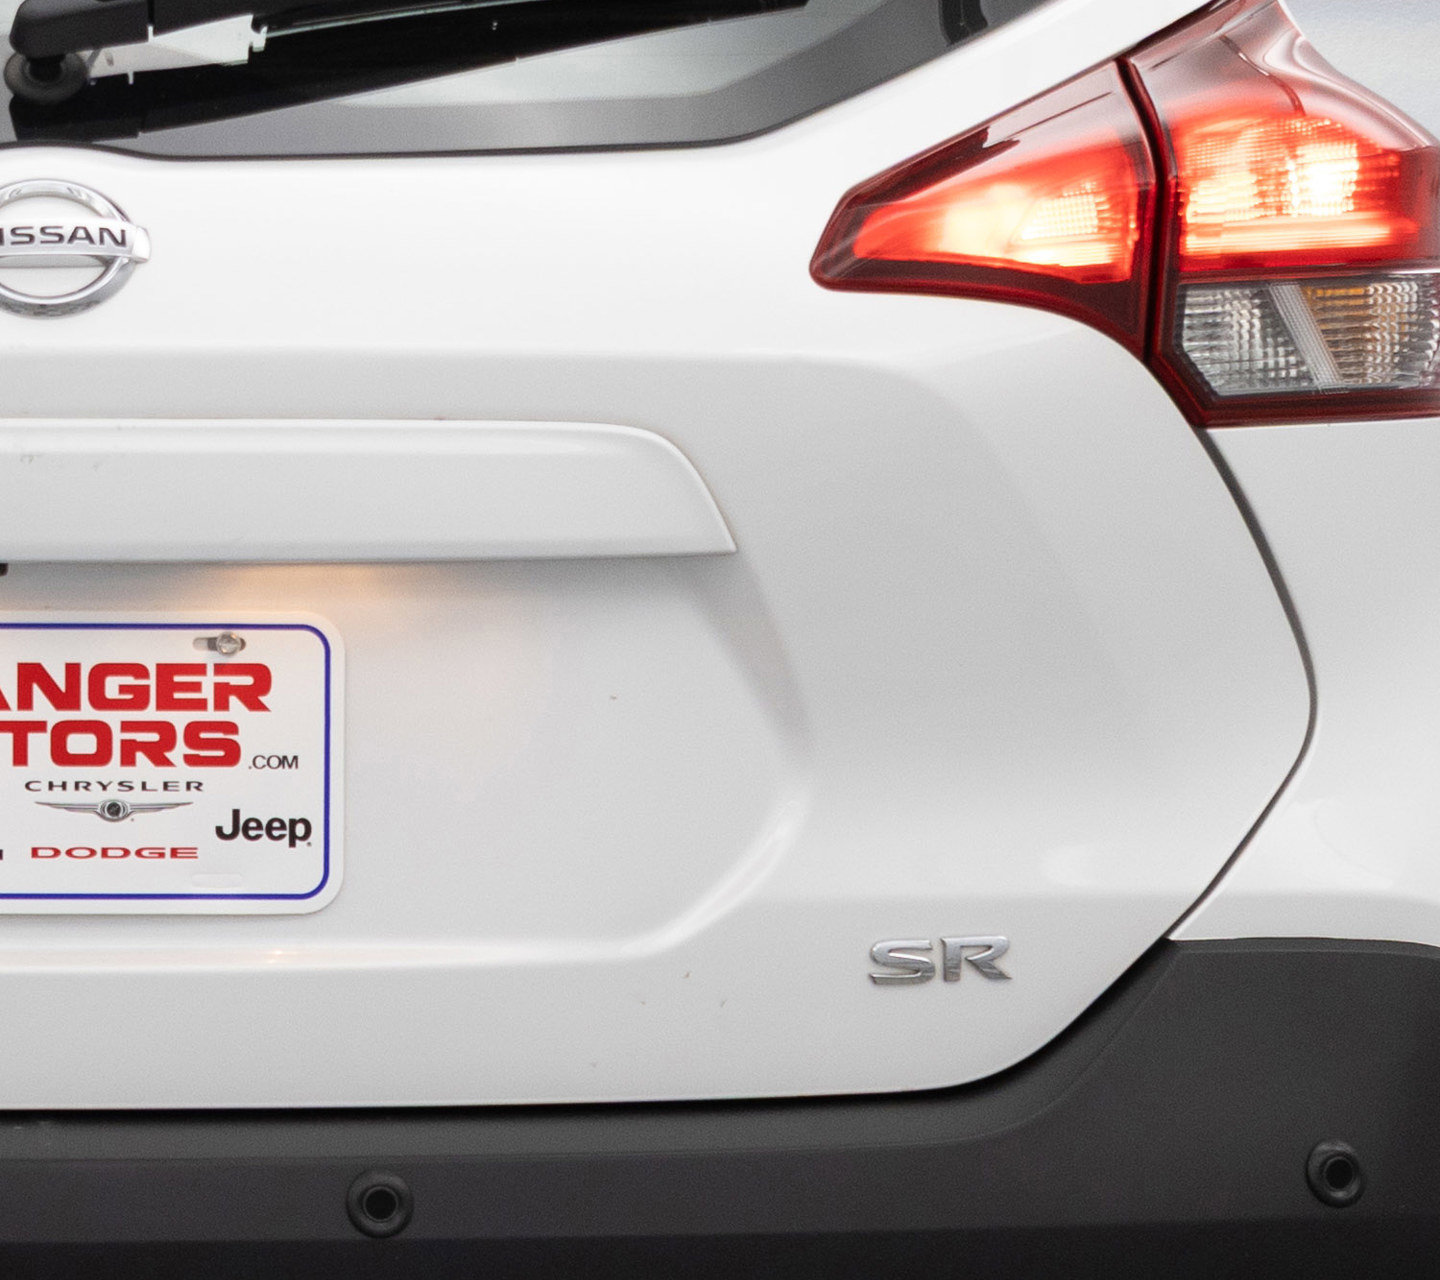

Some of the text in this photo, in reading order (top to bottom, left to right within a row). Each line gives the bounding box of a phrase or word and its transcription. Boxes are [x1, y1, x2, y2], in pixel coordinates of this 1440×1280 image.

[24, 780, 204, 792] CHRYSLER
[215, 808, 312, 848] Jeep
[30, 846, 199, 859] DODGE
[869, 935, 1012, 985] SR
